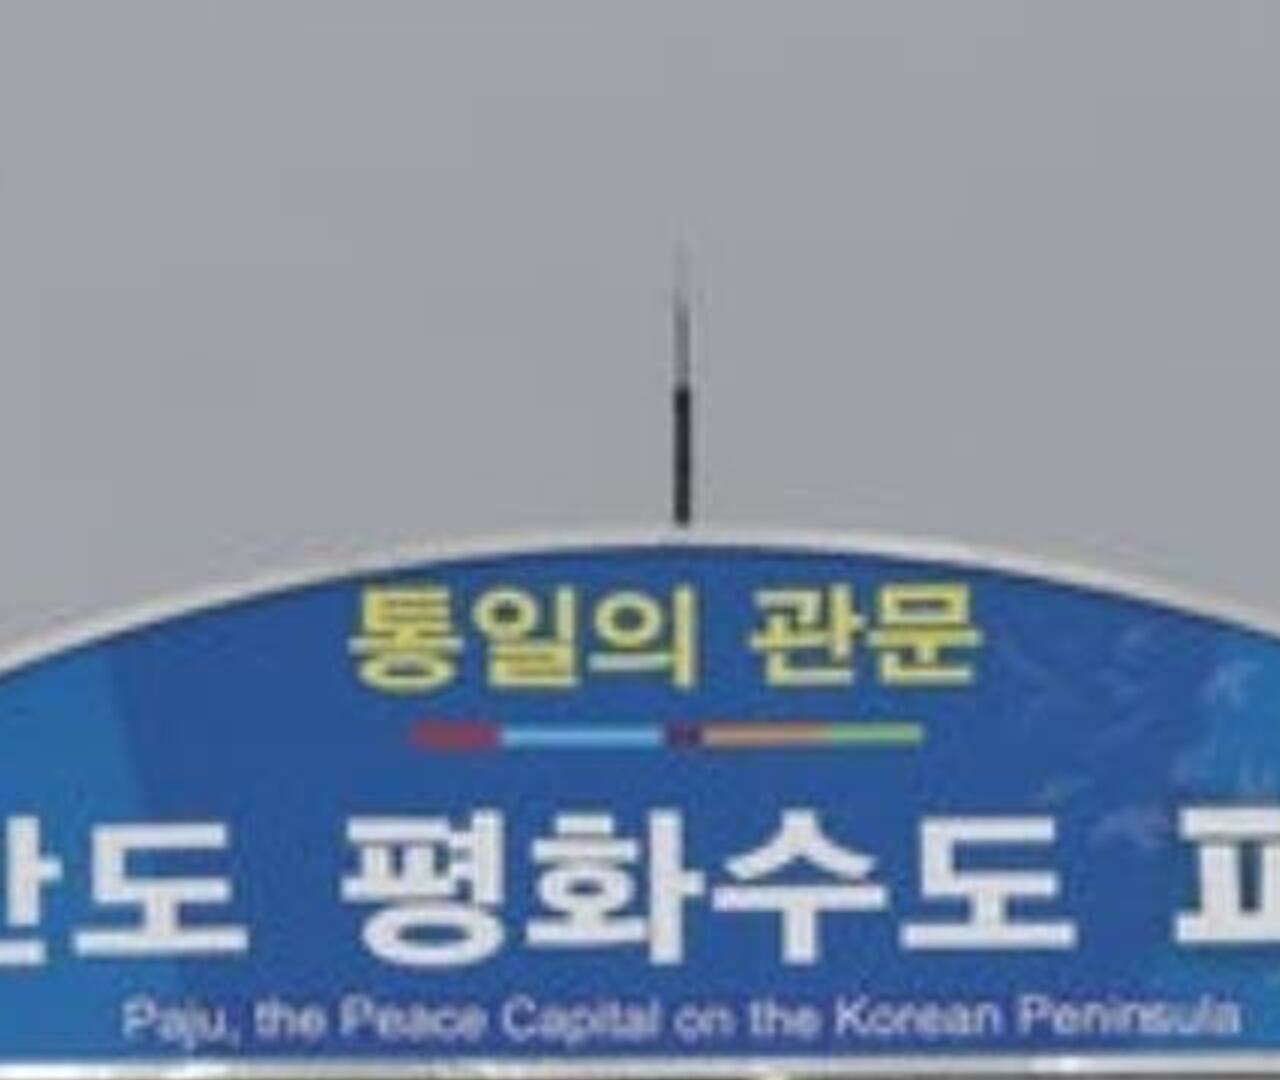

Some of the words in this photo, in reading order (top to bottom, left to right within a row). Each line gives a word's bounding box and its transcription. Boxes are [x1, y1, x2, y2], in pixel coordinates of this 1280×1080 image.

[349, 584, 700, 690] 통일의
[749, 584, 982, 687] 관문
[341, 808, 1078, 966] 평화수도
[122, 998, 240, 1046] Paju,
[254, 1000, 323, 1037] the
[340, 998, 489, 1037] Peace
[502, 996, 660, 1044] Capital
[674, 1008, 734, 1037] on
[751, 1000, 818, 1037] the
[833, 998, 1002, 1037] Korean
[1019, 996, 1241, 1036] Peninsula
